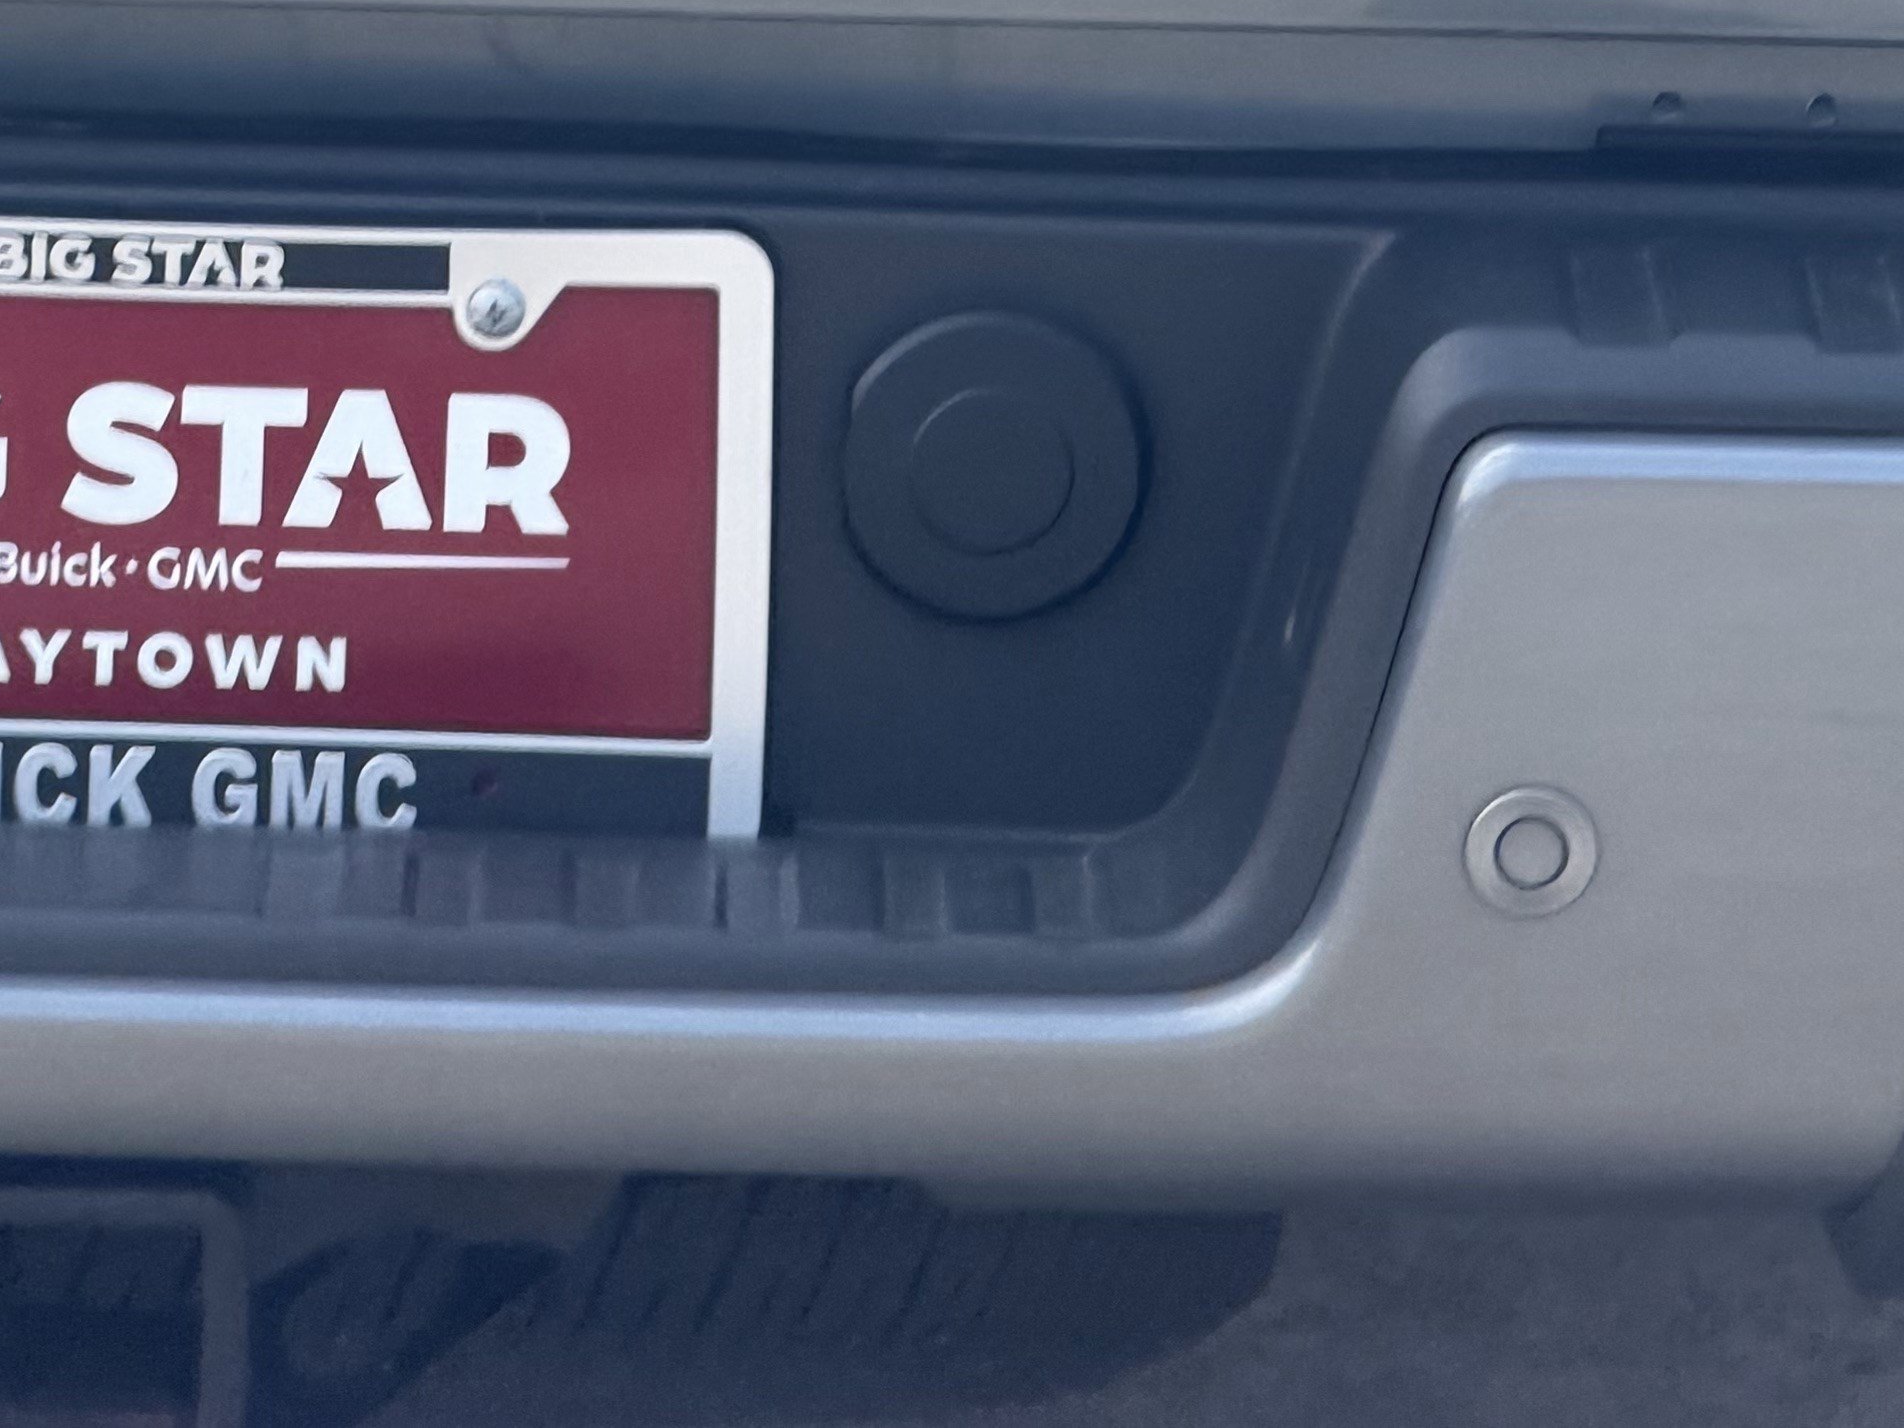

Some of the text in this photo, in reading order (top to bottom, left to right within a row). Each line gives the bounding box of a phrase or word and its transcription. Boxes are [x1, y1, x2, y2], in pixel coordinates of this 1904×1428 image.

[111, 237, 285, 291] STAR
[61, 380, 571, 537] STAR
[147, 546, 264, 595] GMC
[190, 748, 419, 833] GMC
